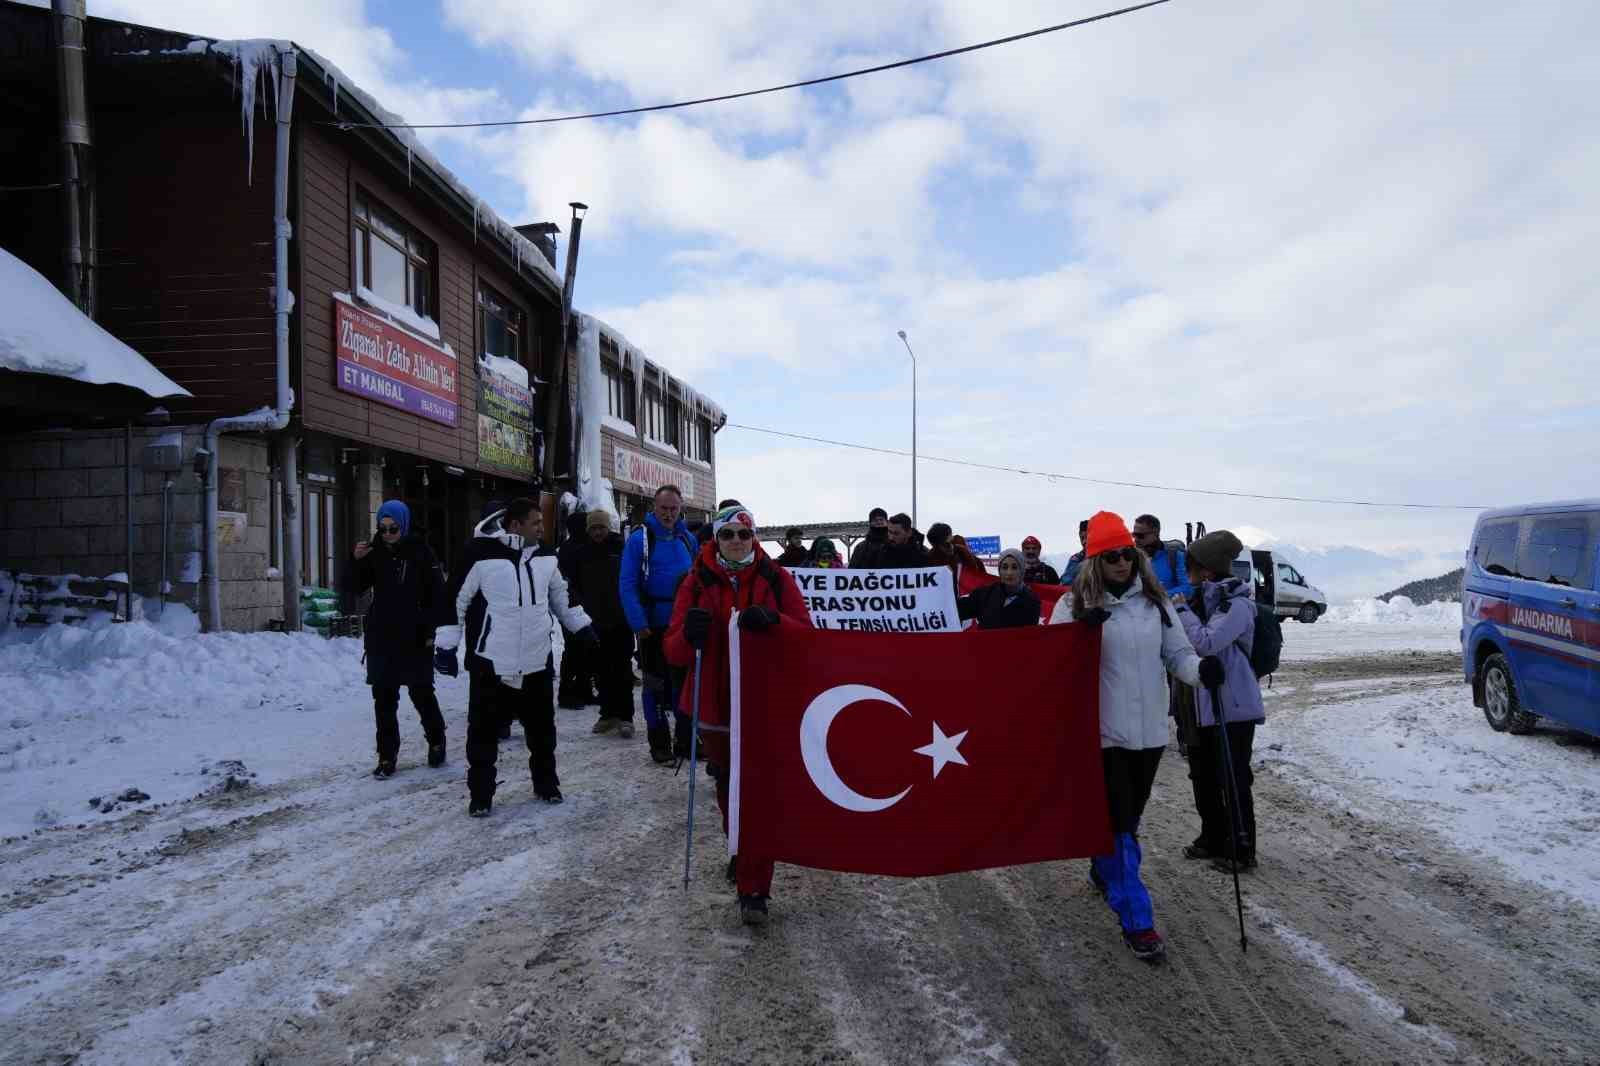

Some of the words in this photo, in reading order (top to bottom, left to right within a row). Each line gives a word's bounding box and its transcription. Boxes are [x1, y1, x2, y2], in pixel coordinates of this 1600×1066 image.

[344, 366, 358, 385] ET
[361, 373, 405, 402] MANGAL
[834, 572, 938, 591] DAĞCILIK
[837, 611, 948, 632] TEMSİLCİLİĞİ
[1511, 607, 1573, 640] JANDARMA
